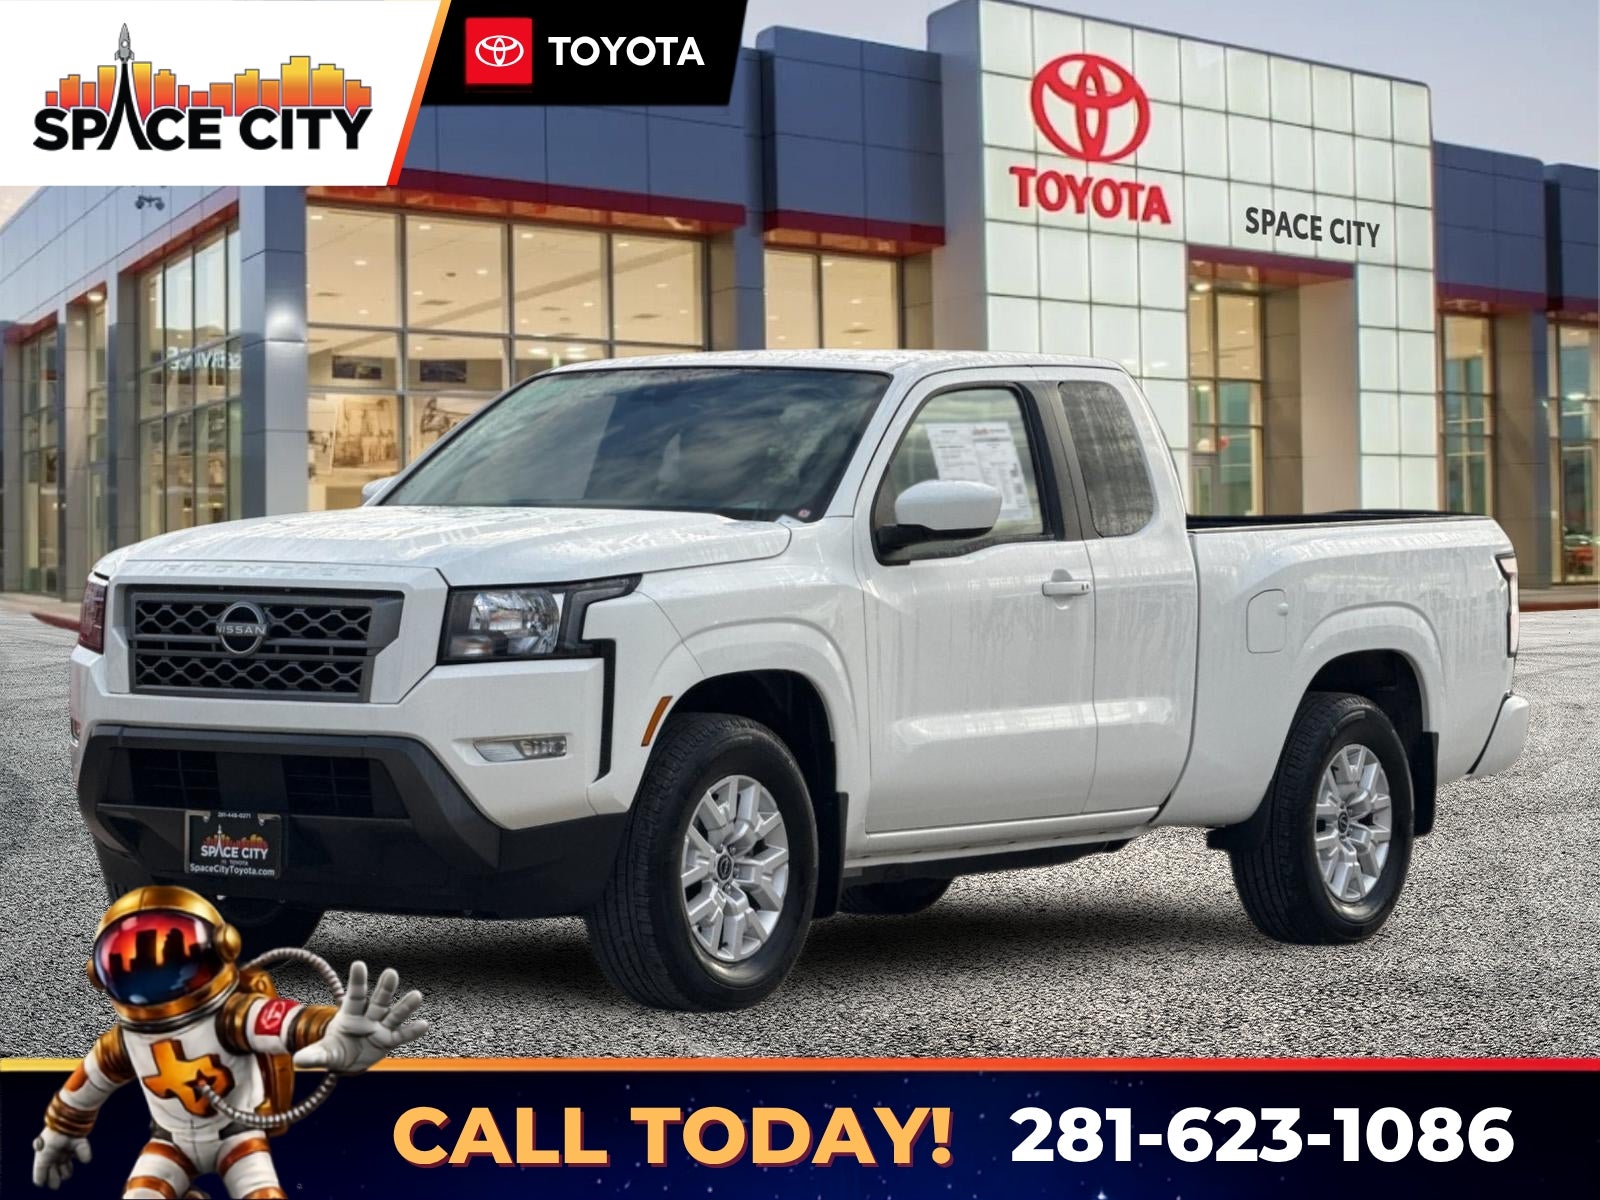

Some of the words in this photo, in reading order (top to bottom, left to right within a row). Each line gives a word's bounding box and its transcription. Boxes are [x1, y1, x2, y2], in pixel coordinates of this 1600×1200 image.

[1009, 166, 1171, 224] TOYOTA
[1245, 206, 1323, 242] SPACE
[1329, 217, 1381, 248] CITY
[216, 625, 266, 635] NISSAN
[201, 845, 239, 858] SPACE
[241, 847, 269, 860] CITY
[189, 863, 275, 877] SpaceCityToyota.com
